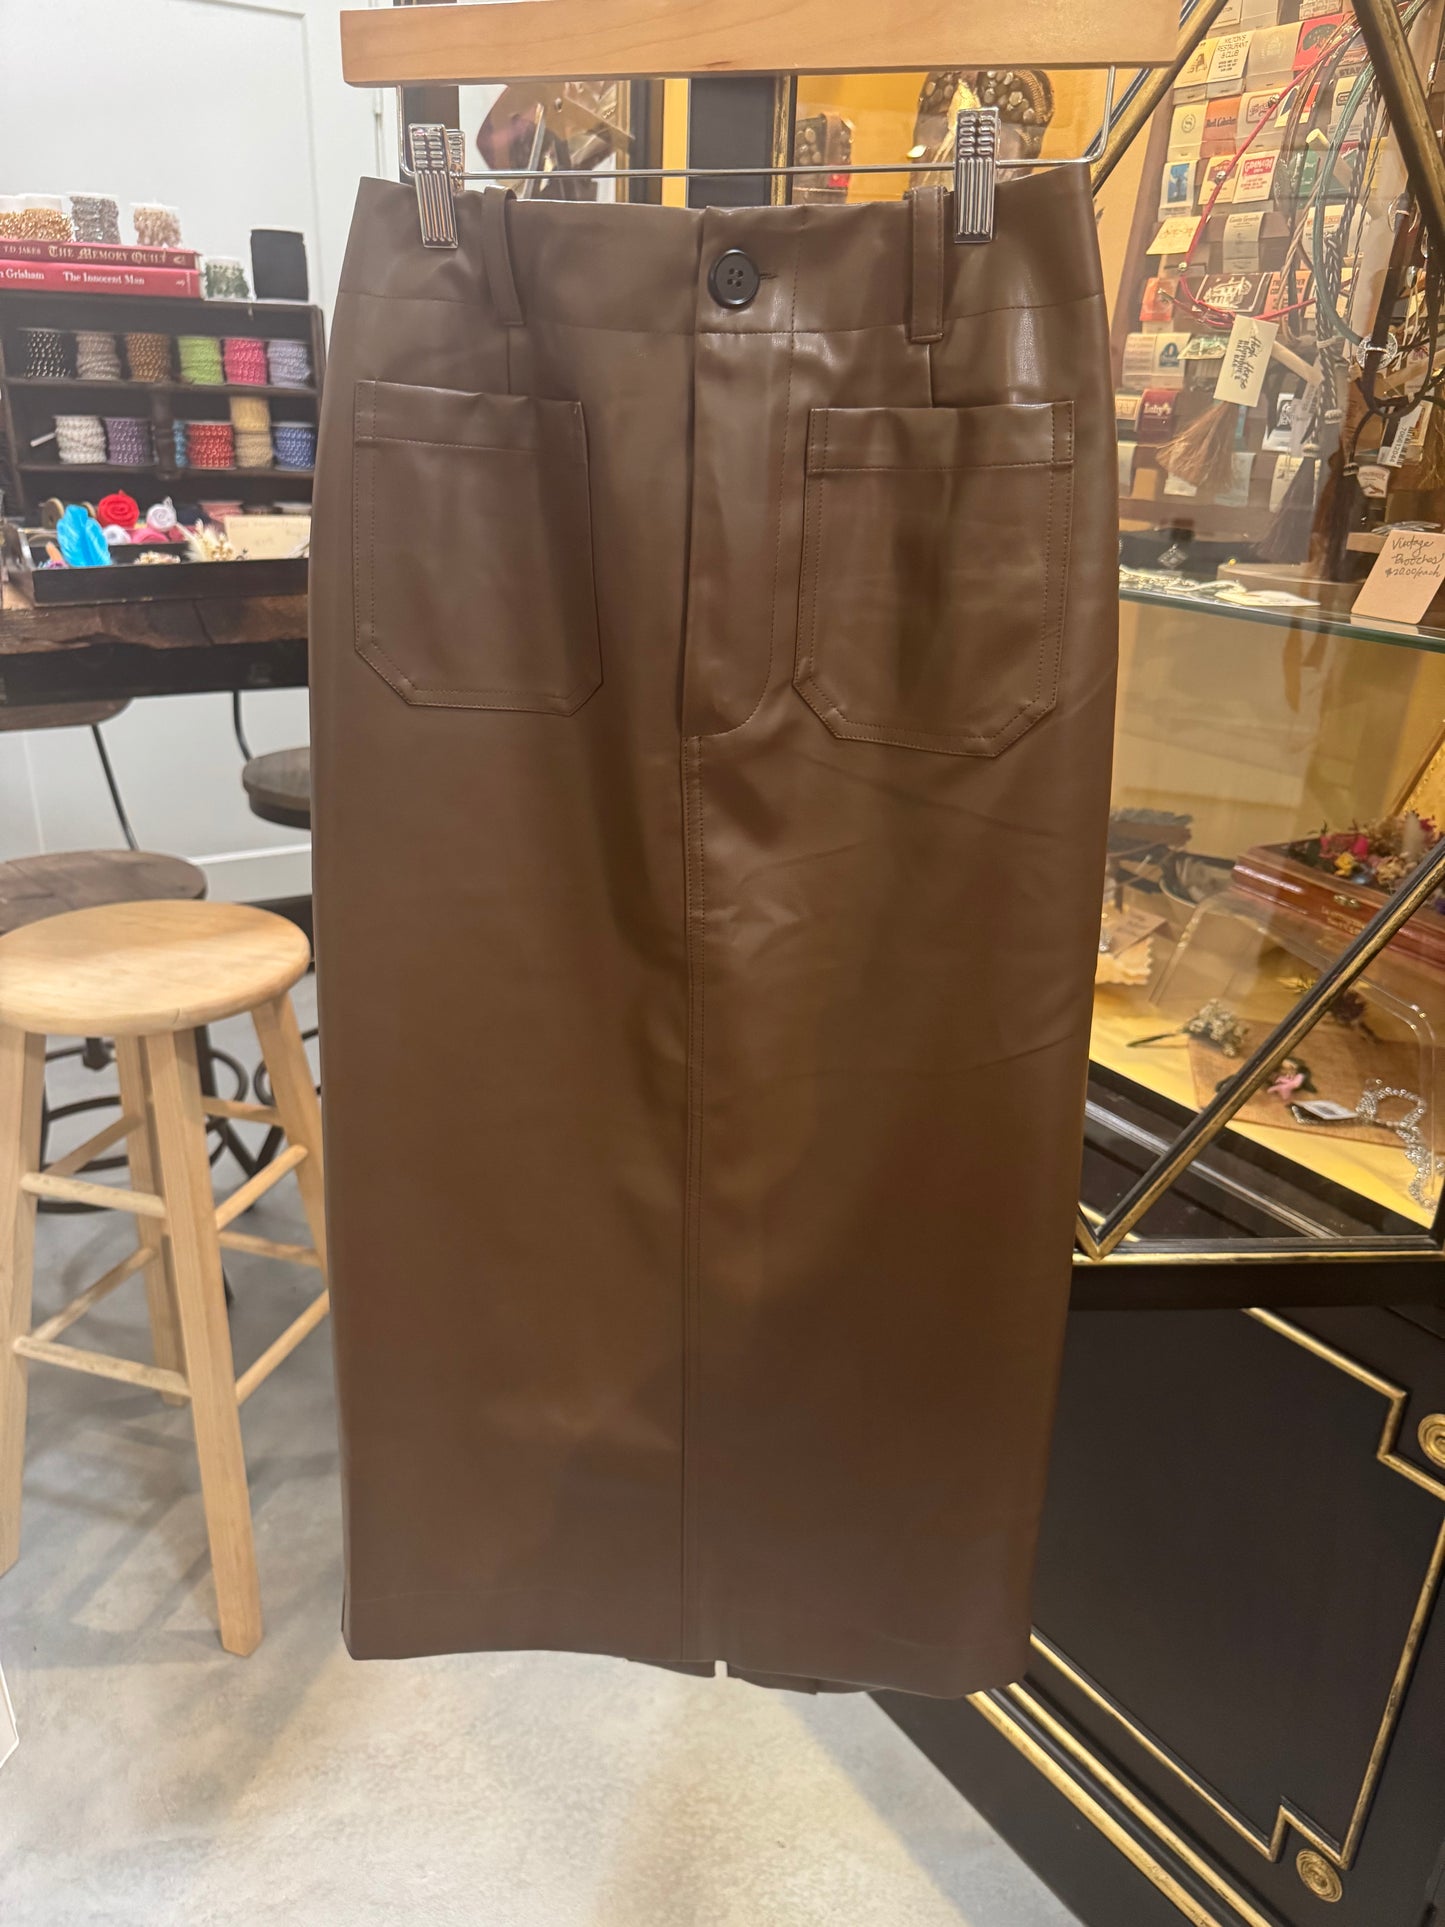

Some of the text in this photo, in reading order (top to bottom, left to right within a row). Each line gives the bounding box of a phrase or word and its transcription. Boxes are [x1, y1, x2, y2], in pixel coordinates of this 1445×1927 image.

[48, 245, 74, 257] THE
[77, 247, 128, 261] MEMORY
[131, 250, 167, 265] QUILT
[5, 268, 45, 280] Grisham
[62, 271, 81, 282] The
[82, 272, 122, 284] Innocent
[124, 274, 145, 285] Man
[1239, 361, 1256, 390] Horse
[1392, 535, 1433, 557] Vintage
[1391, 553, 1445, 566] Brooches
